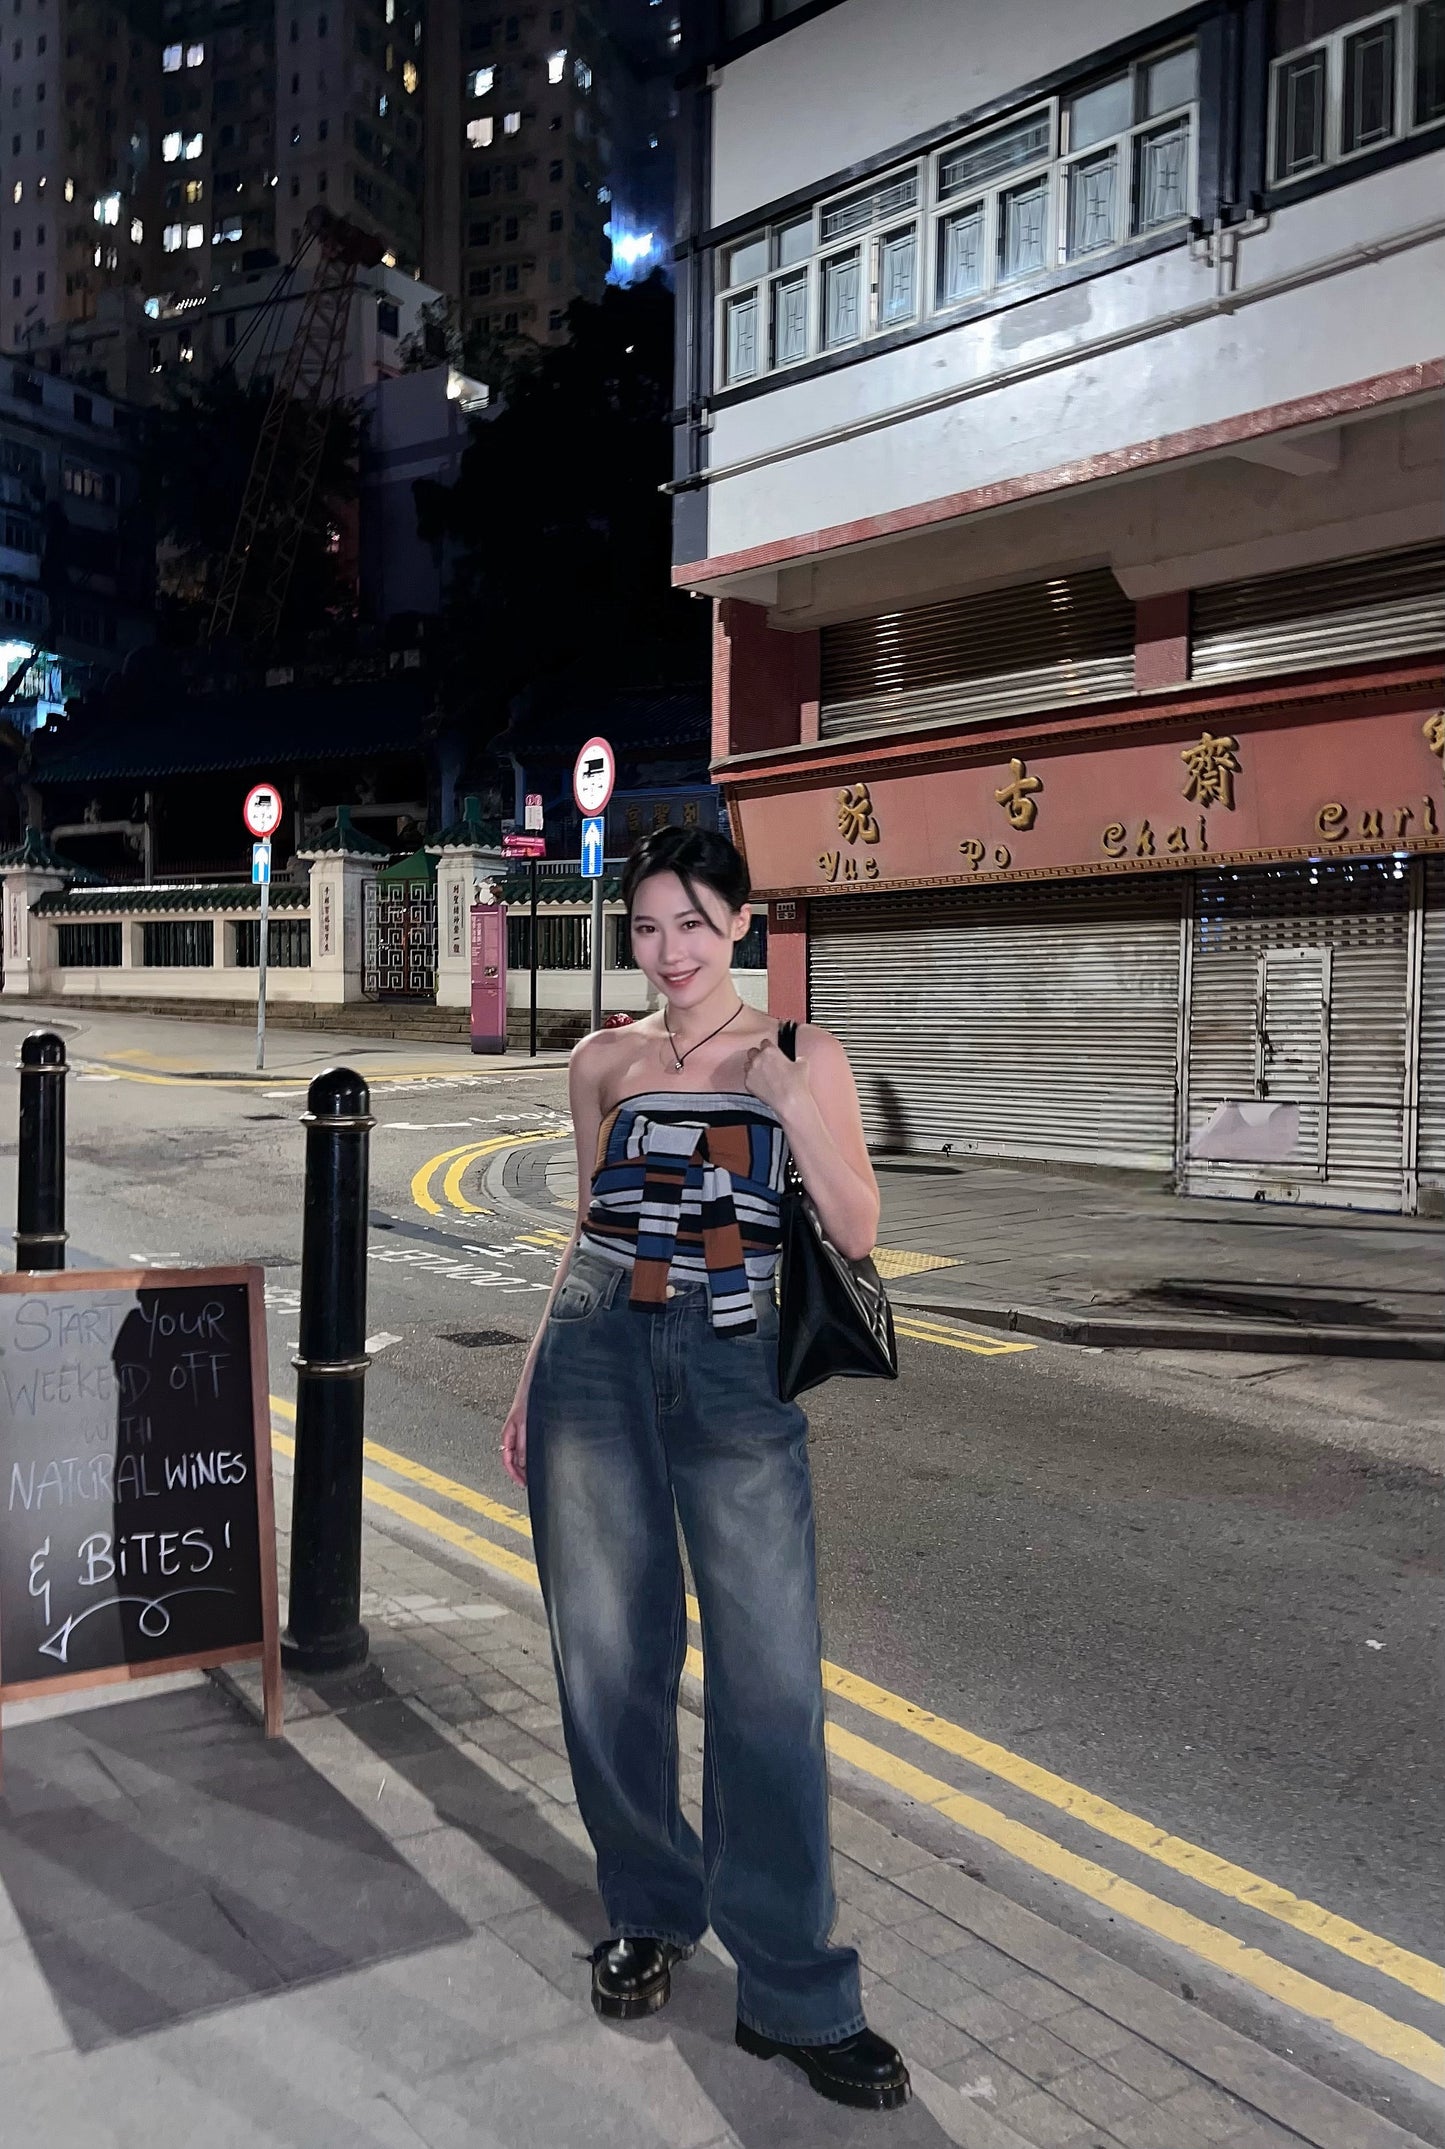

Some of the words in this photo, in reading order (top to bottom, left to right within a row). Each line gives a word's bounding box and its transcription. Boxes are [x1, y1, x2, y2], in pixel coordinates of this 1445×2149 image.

[817, 849, 880, 882] Yue
[959, 838, 1011, 871] Po
[1103, 814, 1208, 858] Chai
[1315, 795, 1438, 842] Curi
[468, 1111, 566, 1123] LOOK
[14, 1298, 123, 1351] START
[139, 1298, 231, 1358] YOUR
[3, 1361, 151, 1416] WEEKEND
[169, 1351, 231, 1408] OFF
[9, 1454, 160, 1511] NATURAL
